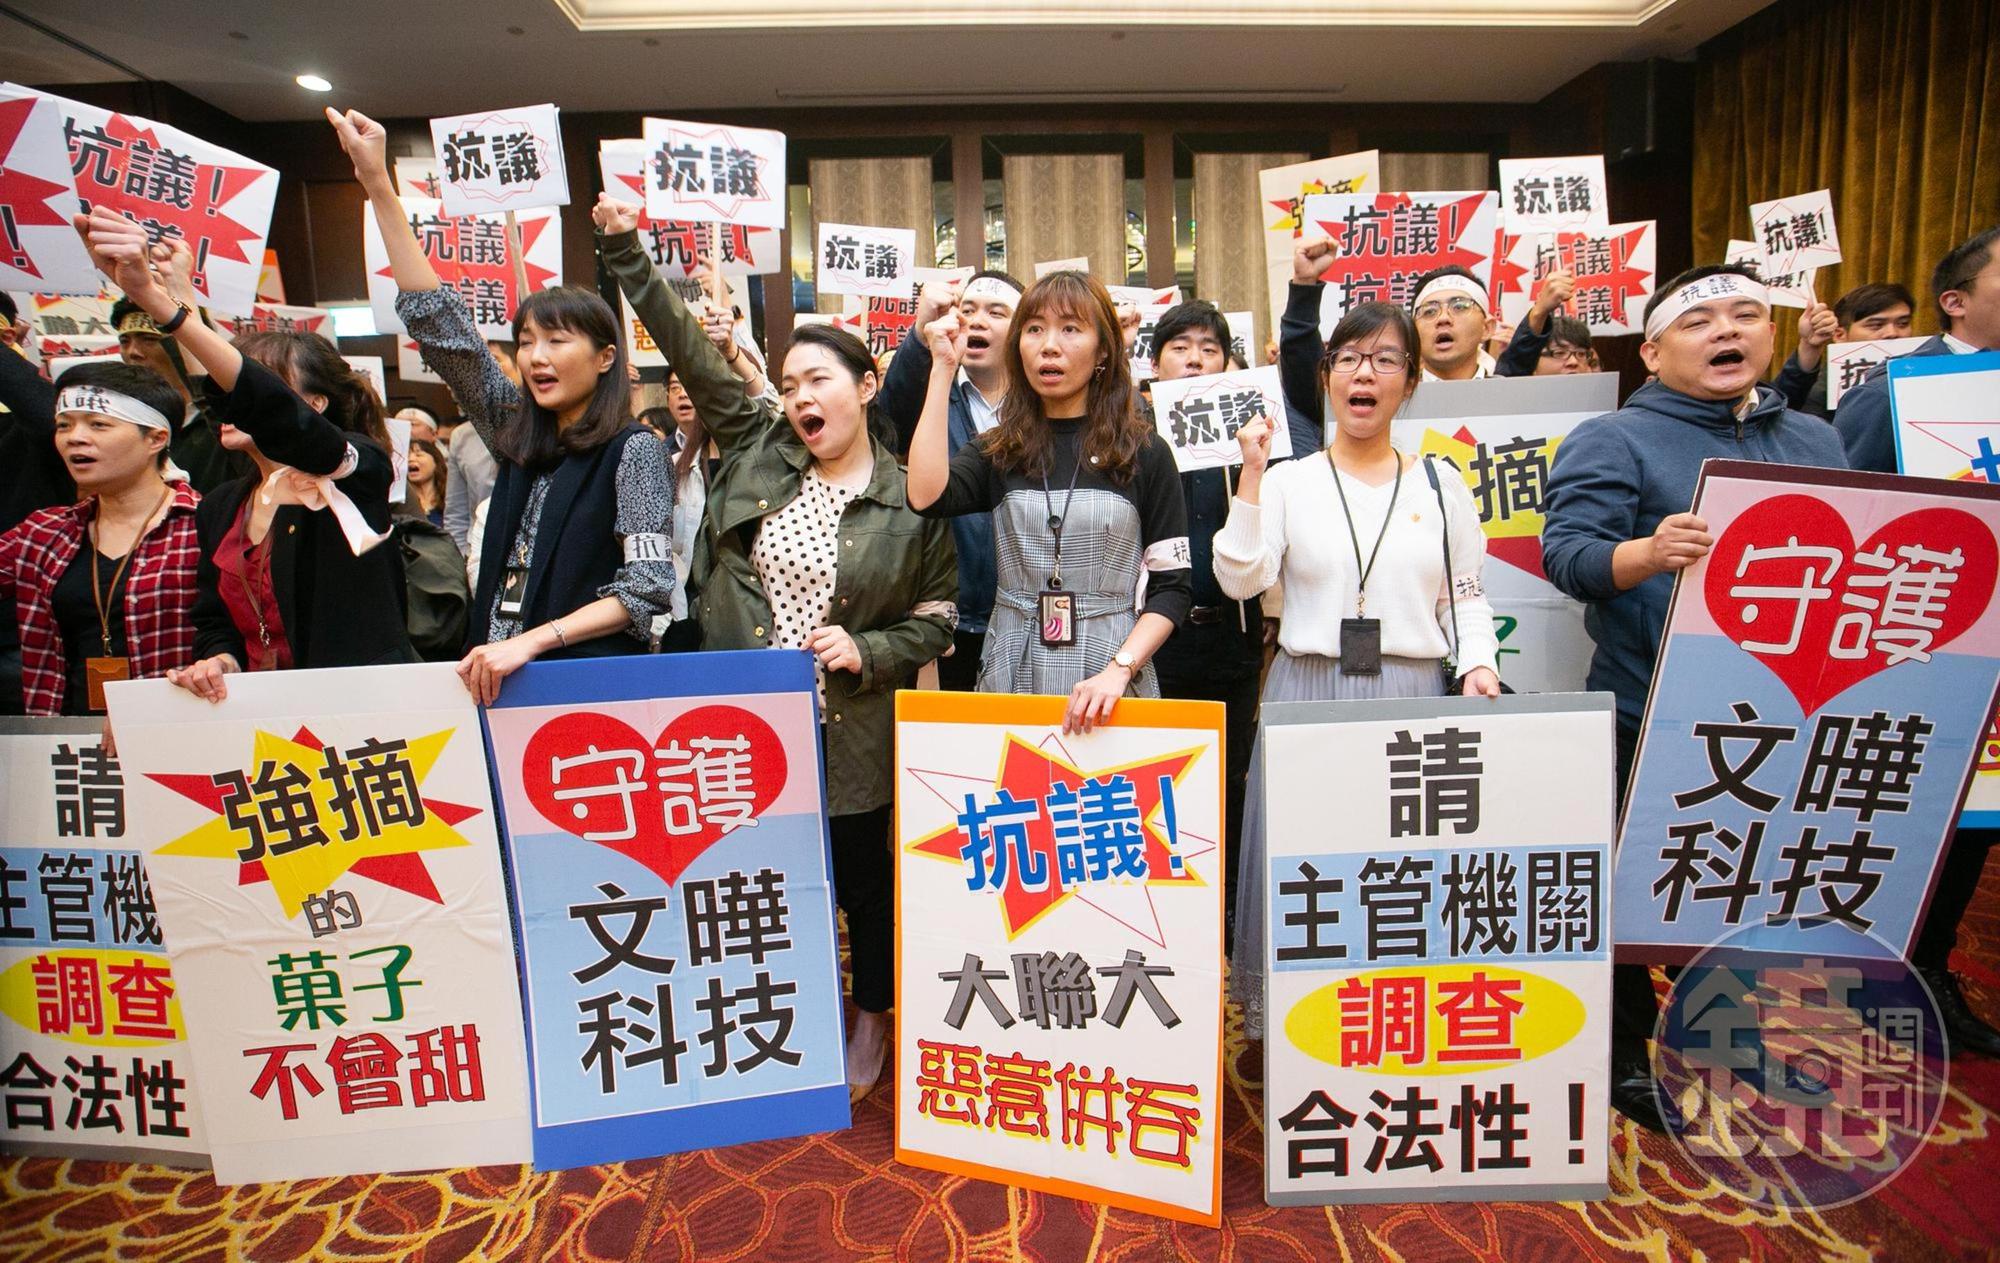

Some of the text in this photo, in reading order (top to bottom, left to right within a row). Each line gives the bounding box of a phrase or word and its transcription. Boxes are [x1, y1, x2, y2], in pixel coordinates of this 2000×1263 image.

[62, 116, 224, 215] 抗議！
[443, 131, 541, 184] 抗議
[653, 142, 760, 197] 抗議
[1514, 176, 1592, 215] 抗議
[825, 235, 898, 279] 抗議
[1341, 203, 1458, 257] 抗議！
[1534, 238, 1627, 281] 抗議！
[1763, 211, 1828, 255] 抗議！
[1168, 390, 1268, 448] 抗議
[1421, 436, 1548, 523] 摘
[1729, 535, 1966, 666] 守護
[52, 744, 126, 838] 請
[212, 737, 426, 864] 強摘
[551, 734, 760, 841] 守護
[1385, 727, 1483, 838] 請
[1673, 702, 1936, 823] 文曄
[957, 774, 1186, 892] 抗議！
[1652, 820, 1896, 935] 科技
[302, 889, 362, 938] 的
[568, 867, 793, 985] 文曄
[1275, 850, 1601, 962] 主管機關
[31, 955, 176, 1039] 調查
[267, 944, 423, 1031] 菓子
[577, 972, 804, 1096] 科技
[938, 949, 1182, 1031] 大聯大
[1337, 972, 1524, 1068] 調查
[0, 1052, 191, 1138] 合法性
[243, 1024, 486, 1121] 不會甜
[916, 1039, 1201, 1170] 惡意併吞
[1278, 1083, 1586, 1180] 合法性！
